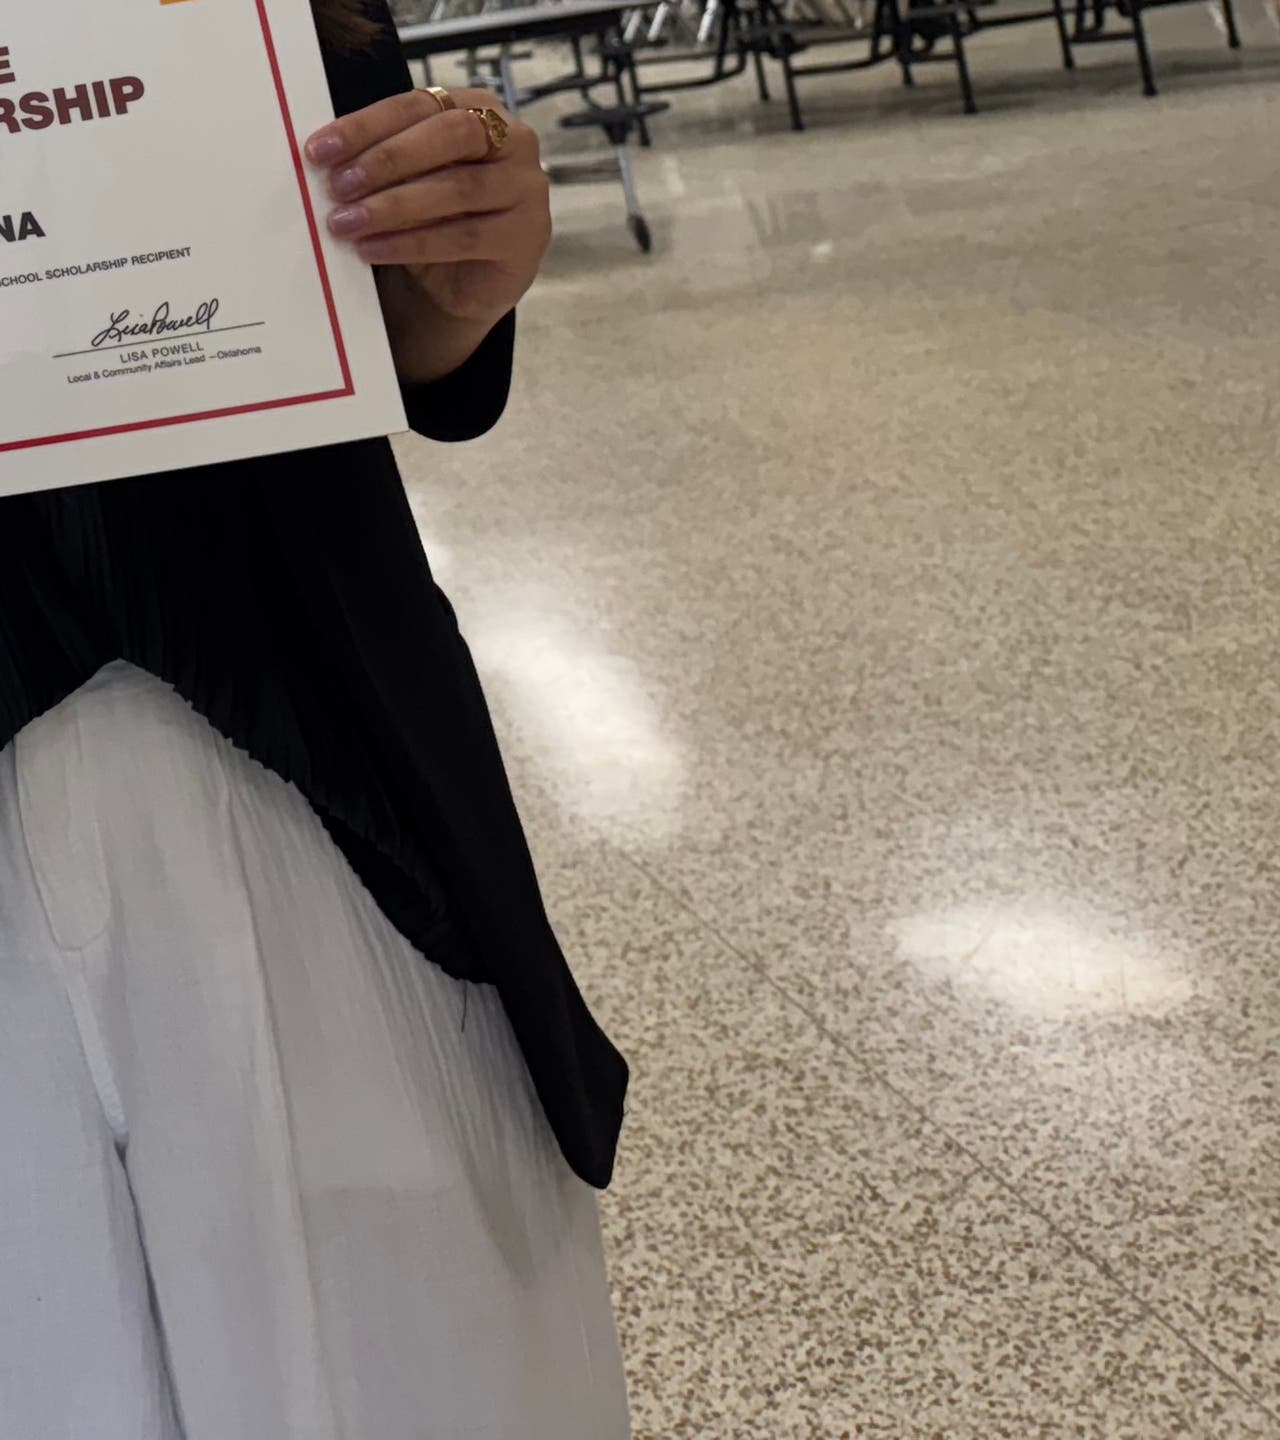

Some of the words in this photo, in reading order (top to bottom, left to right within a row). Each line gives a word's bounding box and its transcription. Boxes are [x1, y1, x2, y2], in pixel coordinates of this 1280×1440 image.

[45, 257, 128, 280] SCHOLARSHIP
[131, 246, 192, 266] RECIPIENT
[120, 350, 148, 364] LISA
[152, 341, 204, 359] POWELL
[67, 372, 91, 384] Local
[93, 371, 100, 380] &
[102, 361, 152, 378] Community
[154, 357, 182, 370] Affairs
